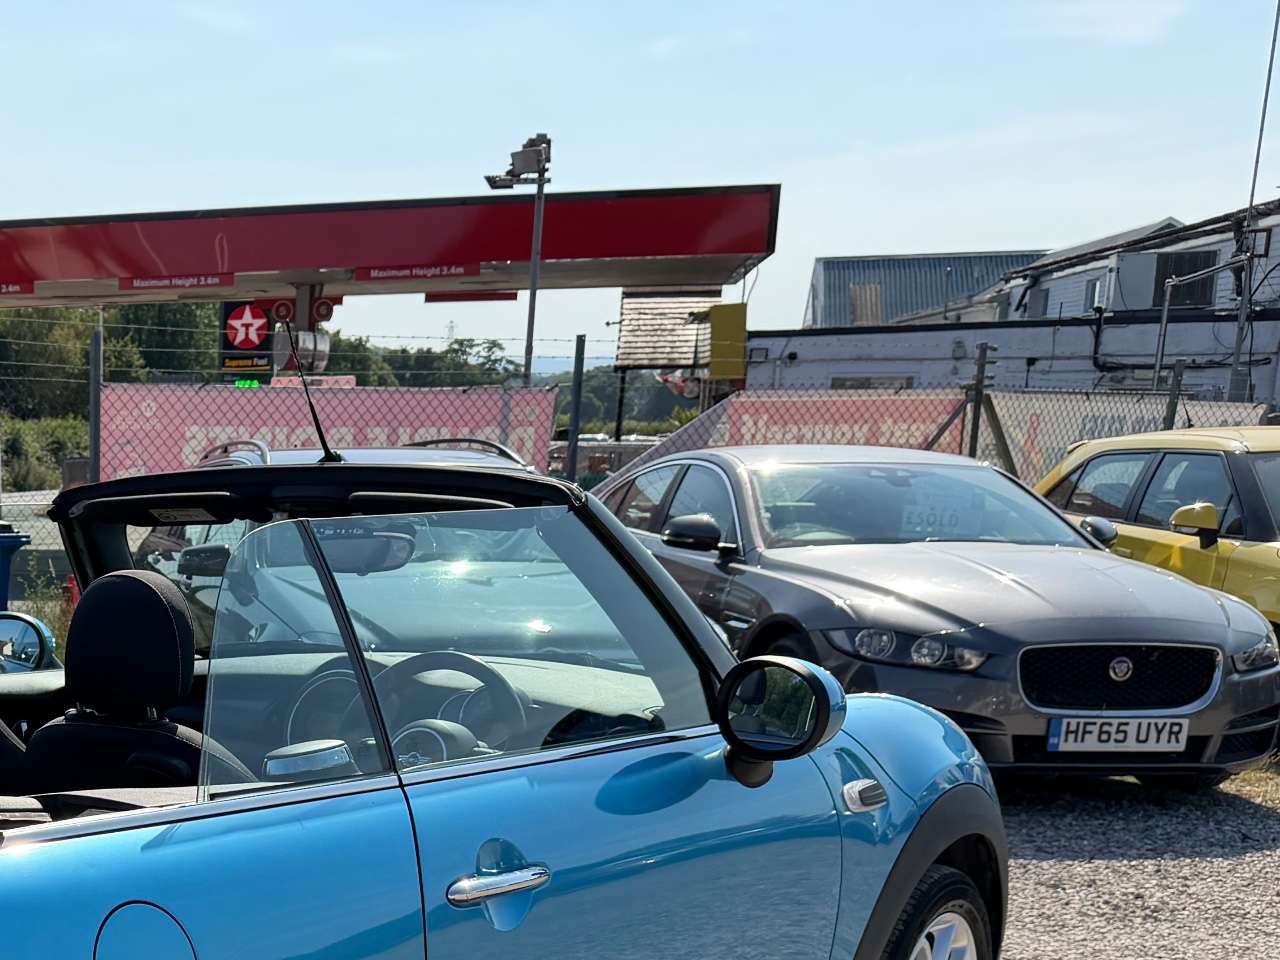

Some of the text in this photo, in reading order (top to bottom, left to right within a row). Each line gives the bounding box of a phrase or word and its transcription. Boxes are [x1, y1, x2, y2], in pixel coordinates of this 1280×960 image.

[370, 265, 465, 278] Maximum Height 3.4m
[132, 278, 170, 288] Maximum
[171, 277, 197, 288] Height
[1064, 721, 1183, 744] HF65 UYR
